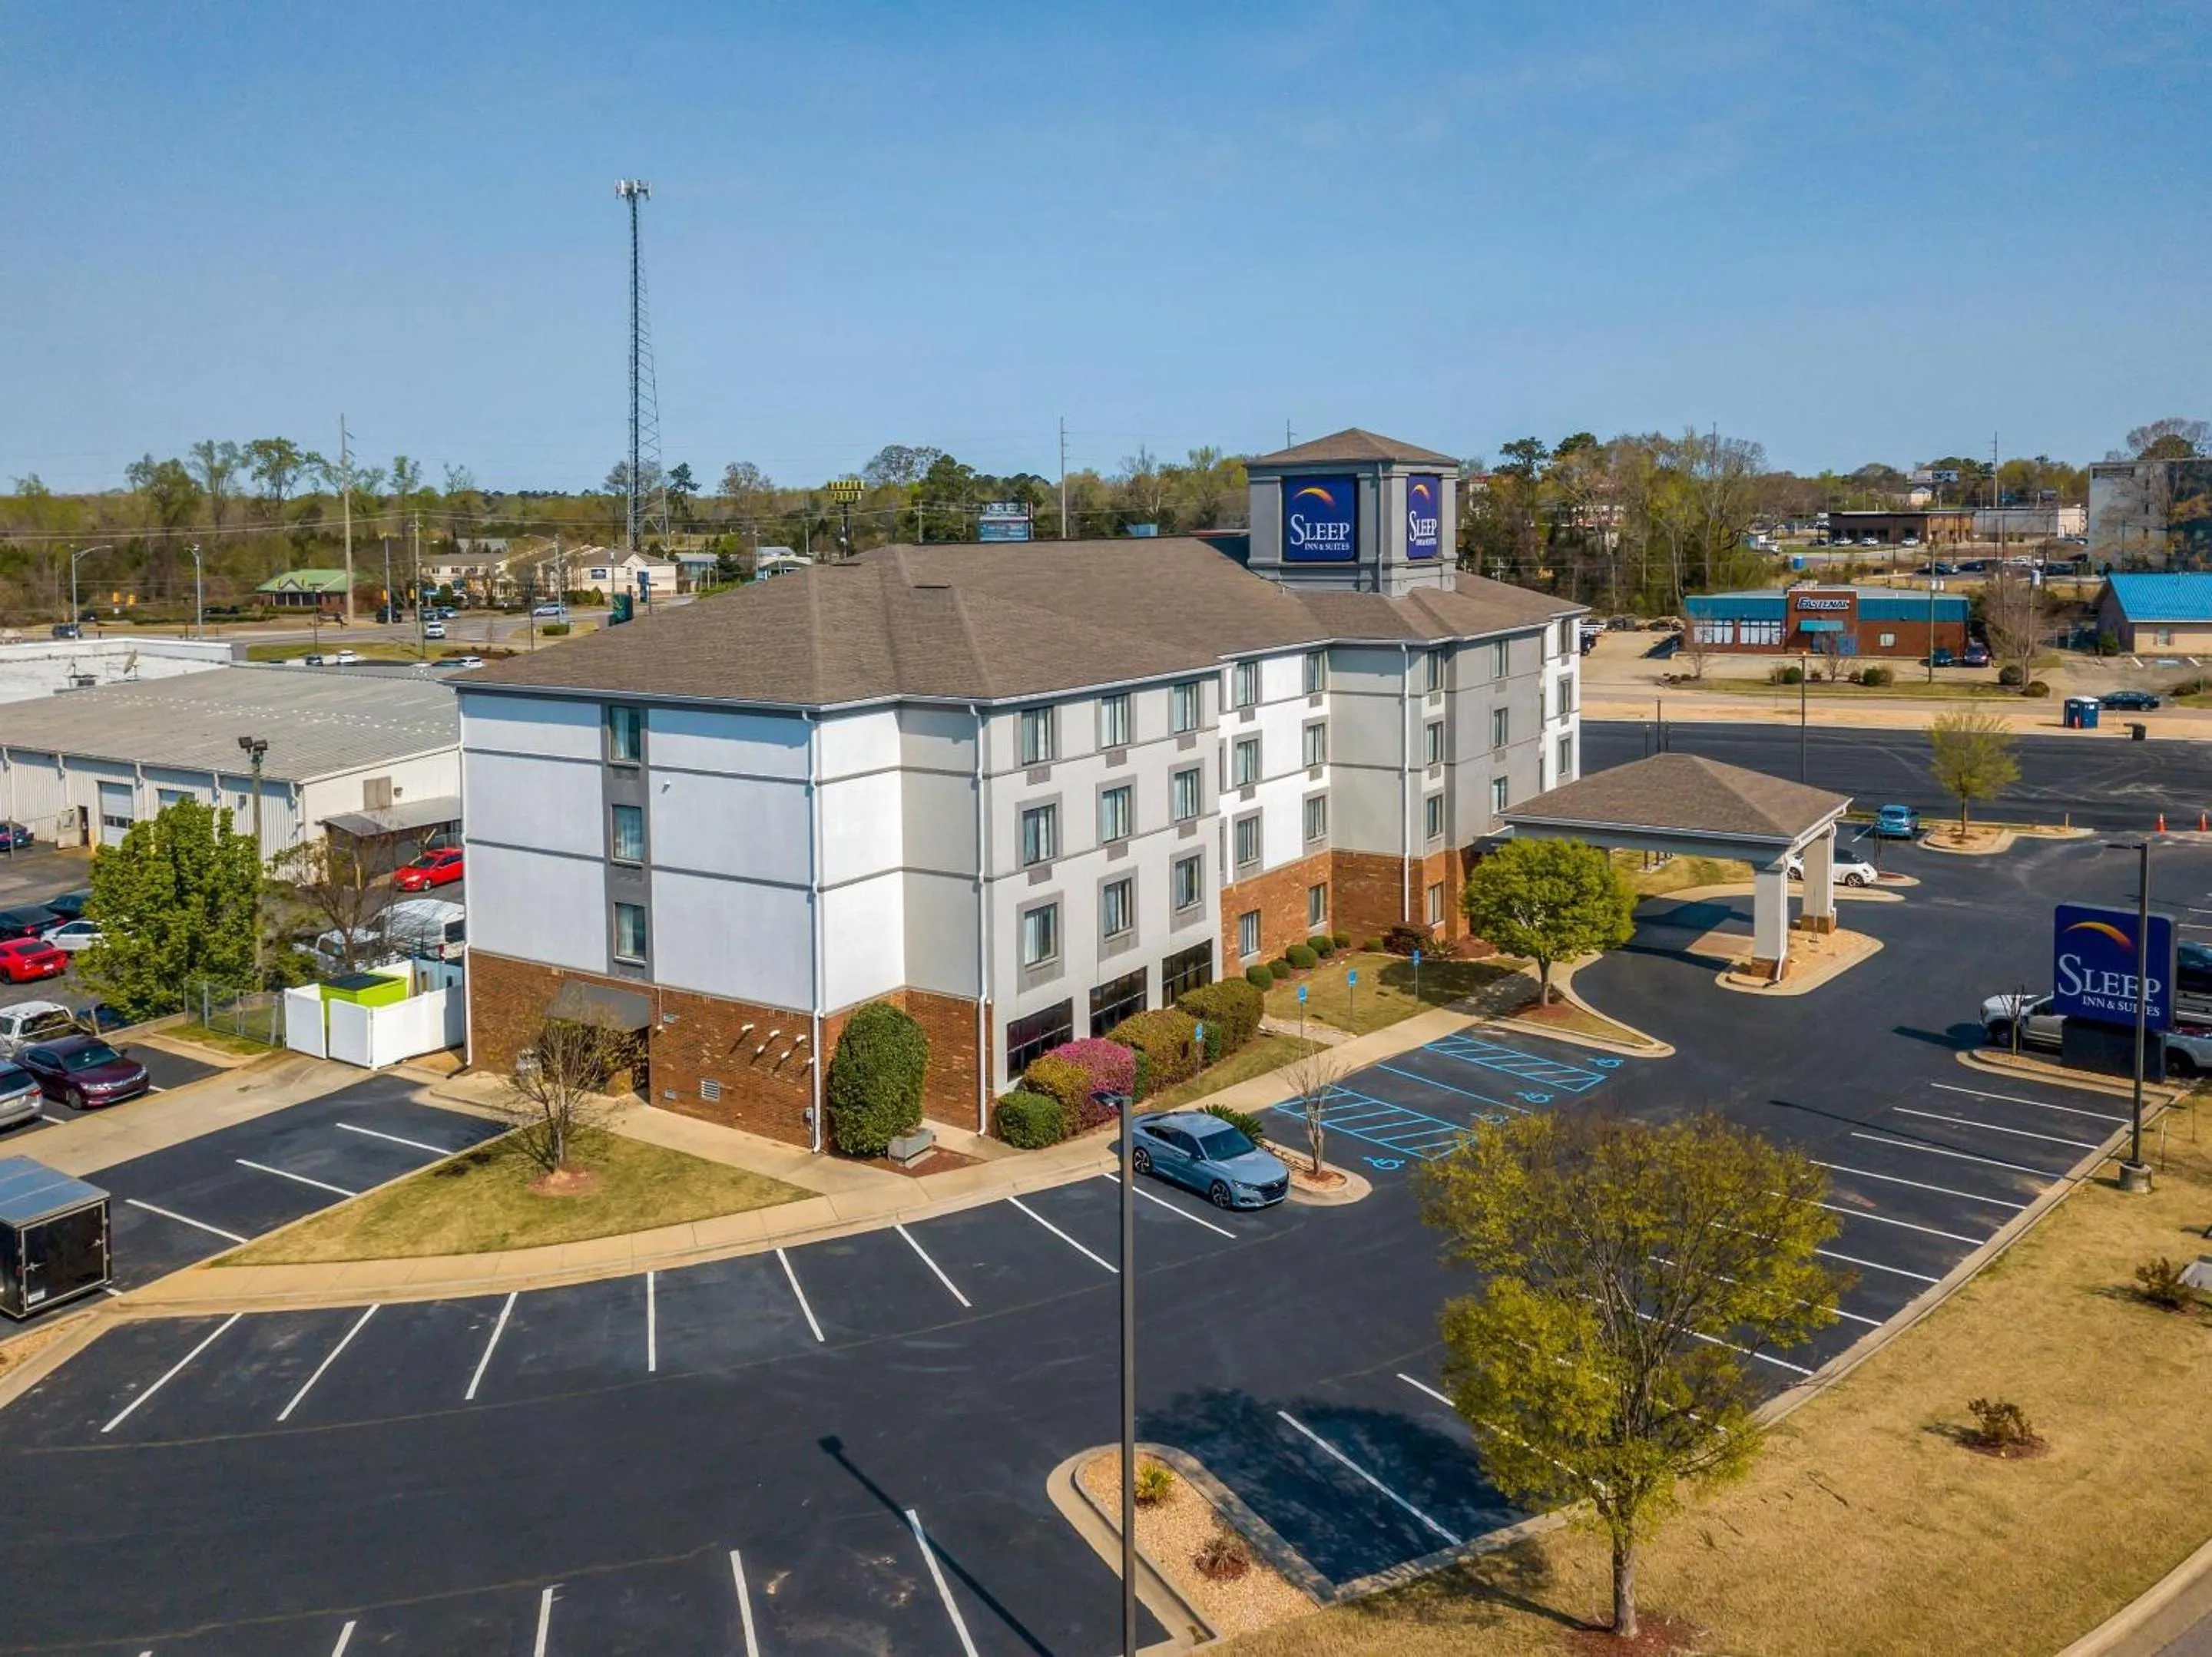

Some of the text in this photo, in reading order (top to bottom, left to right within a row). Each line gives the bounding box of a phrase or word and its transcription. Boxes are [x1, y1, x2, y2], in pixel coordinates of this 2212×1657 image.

[1290, 514, 1350, 545] SLEEP
[1409, 511, 1437, 541] SLEEP
[1304, 542, 1318, 551] INN
[1325, 542, 1350, 551] SUITES
[2058, 953, 2161, 1002] SLEEP
[2082, 995, 2160, 1017] INN & SUIES
